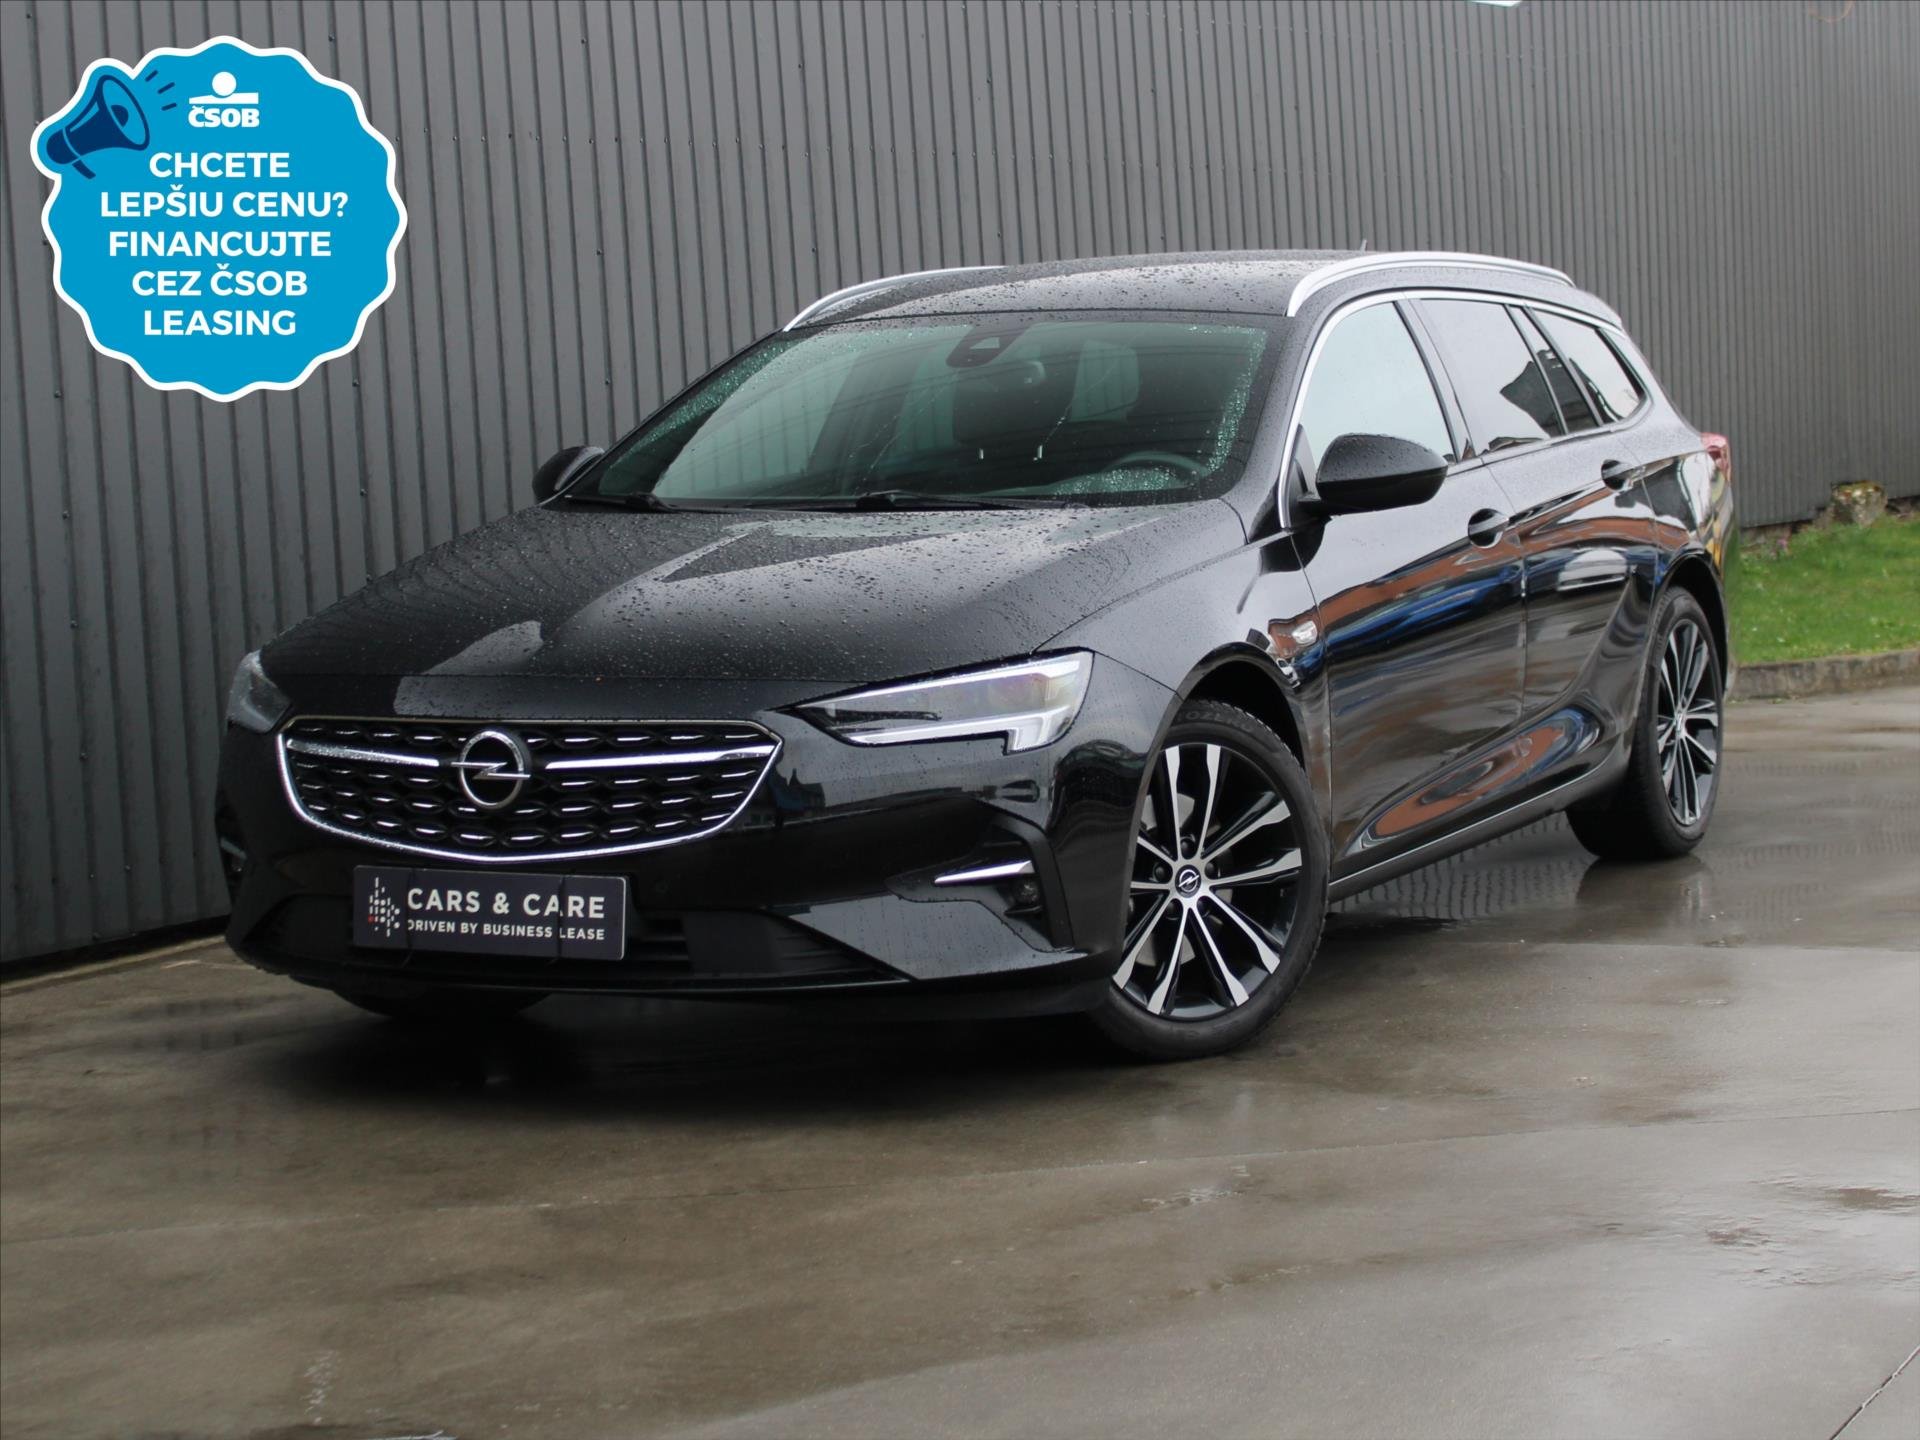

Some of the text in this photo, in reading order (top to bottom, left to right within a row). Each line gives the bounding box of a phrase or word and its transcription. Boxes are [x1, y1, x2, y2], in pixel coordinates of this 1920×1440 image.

[407, 888, 605, 919] CARS & CARE
[407, 918, 605, 941] DRIVEN BY BUSINESS LEASE
